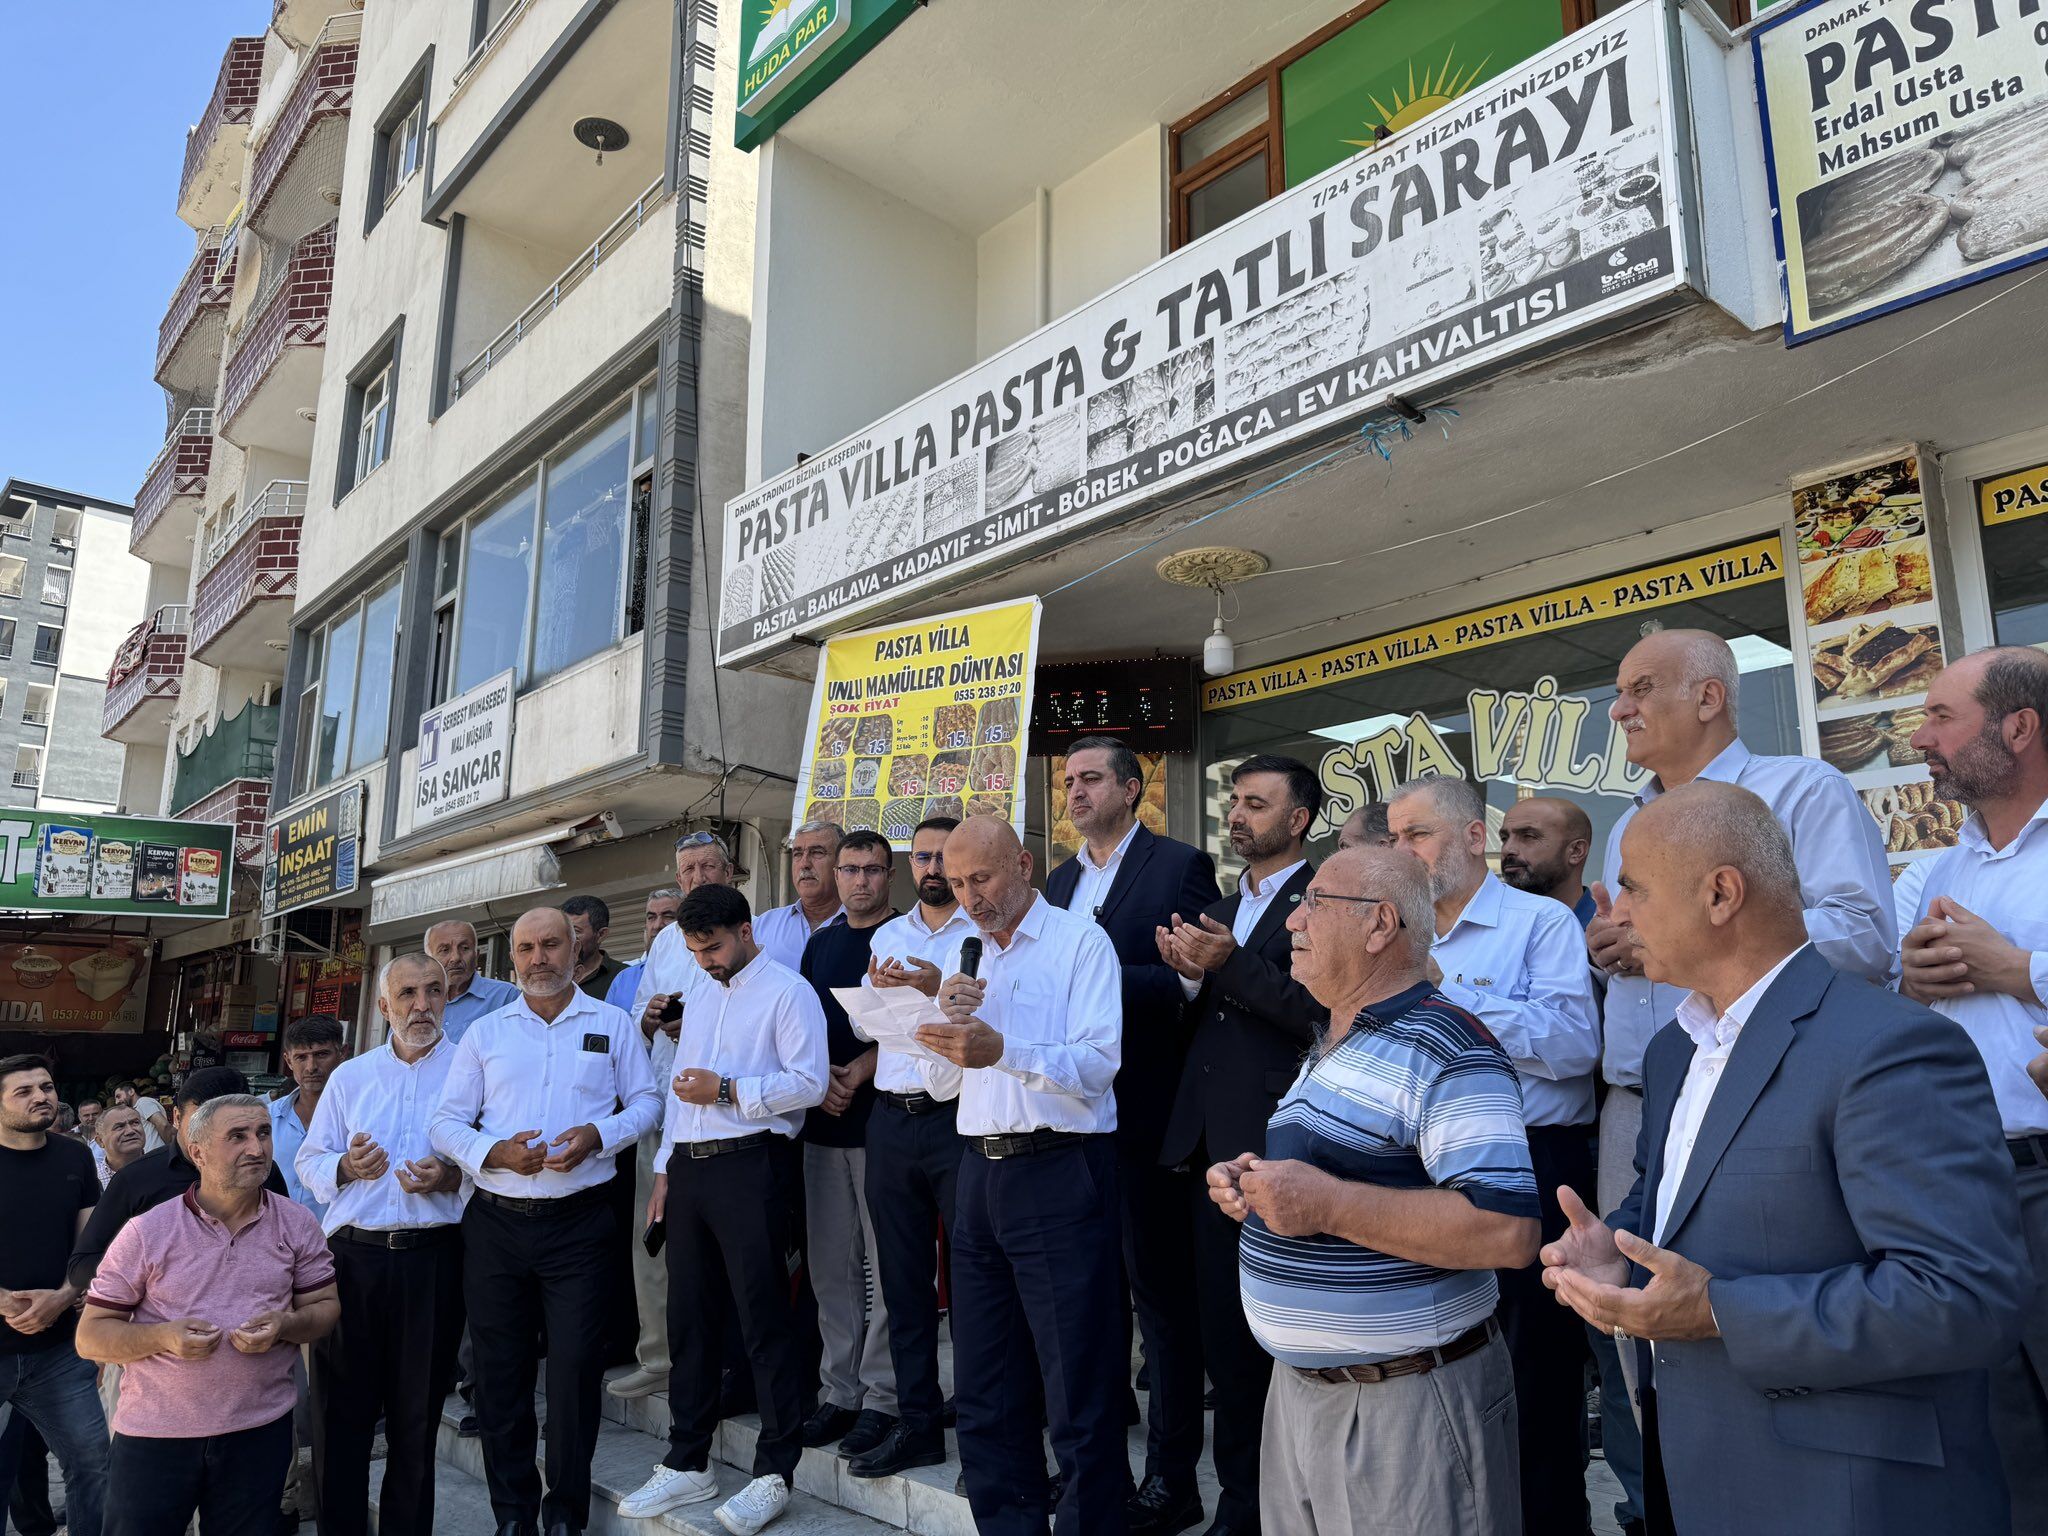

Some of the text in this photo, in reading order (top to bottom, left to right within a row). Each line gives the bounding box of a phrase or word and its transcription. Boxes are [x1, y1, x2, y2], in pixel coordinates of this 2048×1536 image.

[1804, 1, 1871, 42] DAMAK
[744, 5, 828, 97] HÜDA PAR
[1814, 63, 1965, 144] Erdal Usta
[1312, 28, 1628, 208] 7/24 SAAT HİZMETİNİZDEYİZ
[1818, 75, 2025, 177] Mahsum Usta
[1600, 257, 1659, 285] baran
[738, 54, 1634, 563] PASTA VİLLA PASTA & TATLI SARAYI
[753, 607, 798, 640] PASTA
[808, 576, 880, 620] BAKLAVA
[892, 534, 971, 584] KADAYIF
[984, 503, 1043, 545] SİMİT
[1058, 463, 1139, 516] BÖREK
[1158, 411, 1276, 478] POĞAÇA
[1298, 377, 1342, 417] EV
[1347, 281, 1567, 397] KAHVALTISI
[735, 497, 761, 518] DAMAK
[762, 477, 795, 503] TADINIZI
[827, 440, 866, 468] KEŞFEDİN
[1207, 679, 1257, 705] PASTA
[1261, 668, 1308, 693] VİLLA
[1321, 649, 1380, 679] PASTA
[1383, 633, 1440, 662] VİLLA
[1455, 612, 1525, 645] PASTA
[1528, 595, 1595, 627] VİLLA
[1613, 573, 1695, 608] PASTA
[1700, 550, 1779, 588] VİLLA
[875, 623, 970, 662] PASTA VİLLA
[827, 652, 1024, 702] UNLU MAMÜLLER DÜNYASI
[954, 688, 975, 702] 0535
[977, 685, 996, 699] 238
[1008, 681, 1021, 695] 20
[442, 704, 468, 733] SERBEST
[829, 696, 900, 717] ŞOK FİYAT
[869, 740, 885, 754] 15
[947, 731, 965, 747] 15
[985, 725, 1002, 742] 15
[832, 742, 842, 757] 15
[416, 749, 502, 809] İSA SANCAR
[817, 785, 838, 797] 280
[901, 780, 918, 796] 15
[939, 777, 957, 793] 15
[984, 774, 1003, 791] 15
[288, 806, 327, 844] EMİN
[53, 838, 86, 846] KERVAN
[102, 847, 131, 855] KERVAN
[148, 849, 175, 857] KERVAN
[280, 835, 335, 878] İNŞAAT
[52, 1009, 80, 1020] 0537
[83, 1010, 104, 1020] 480
